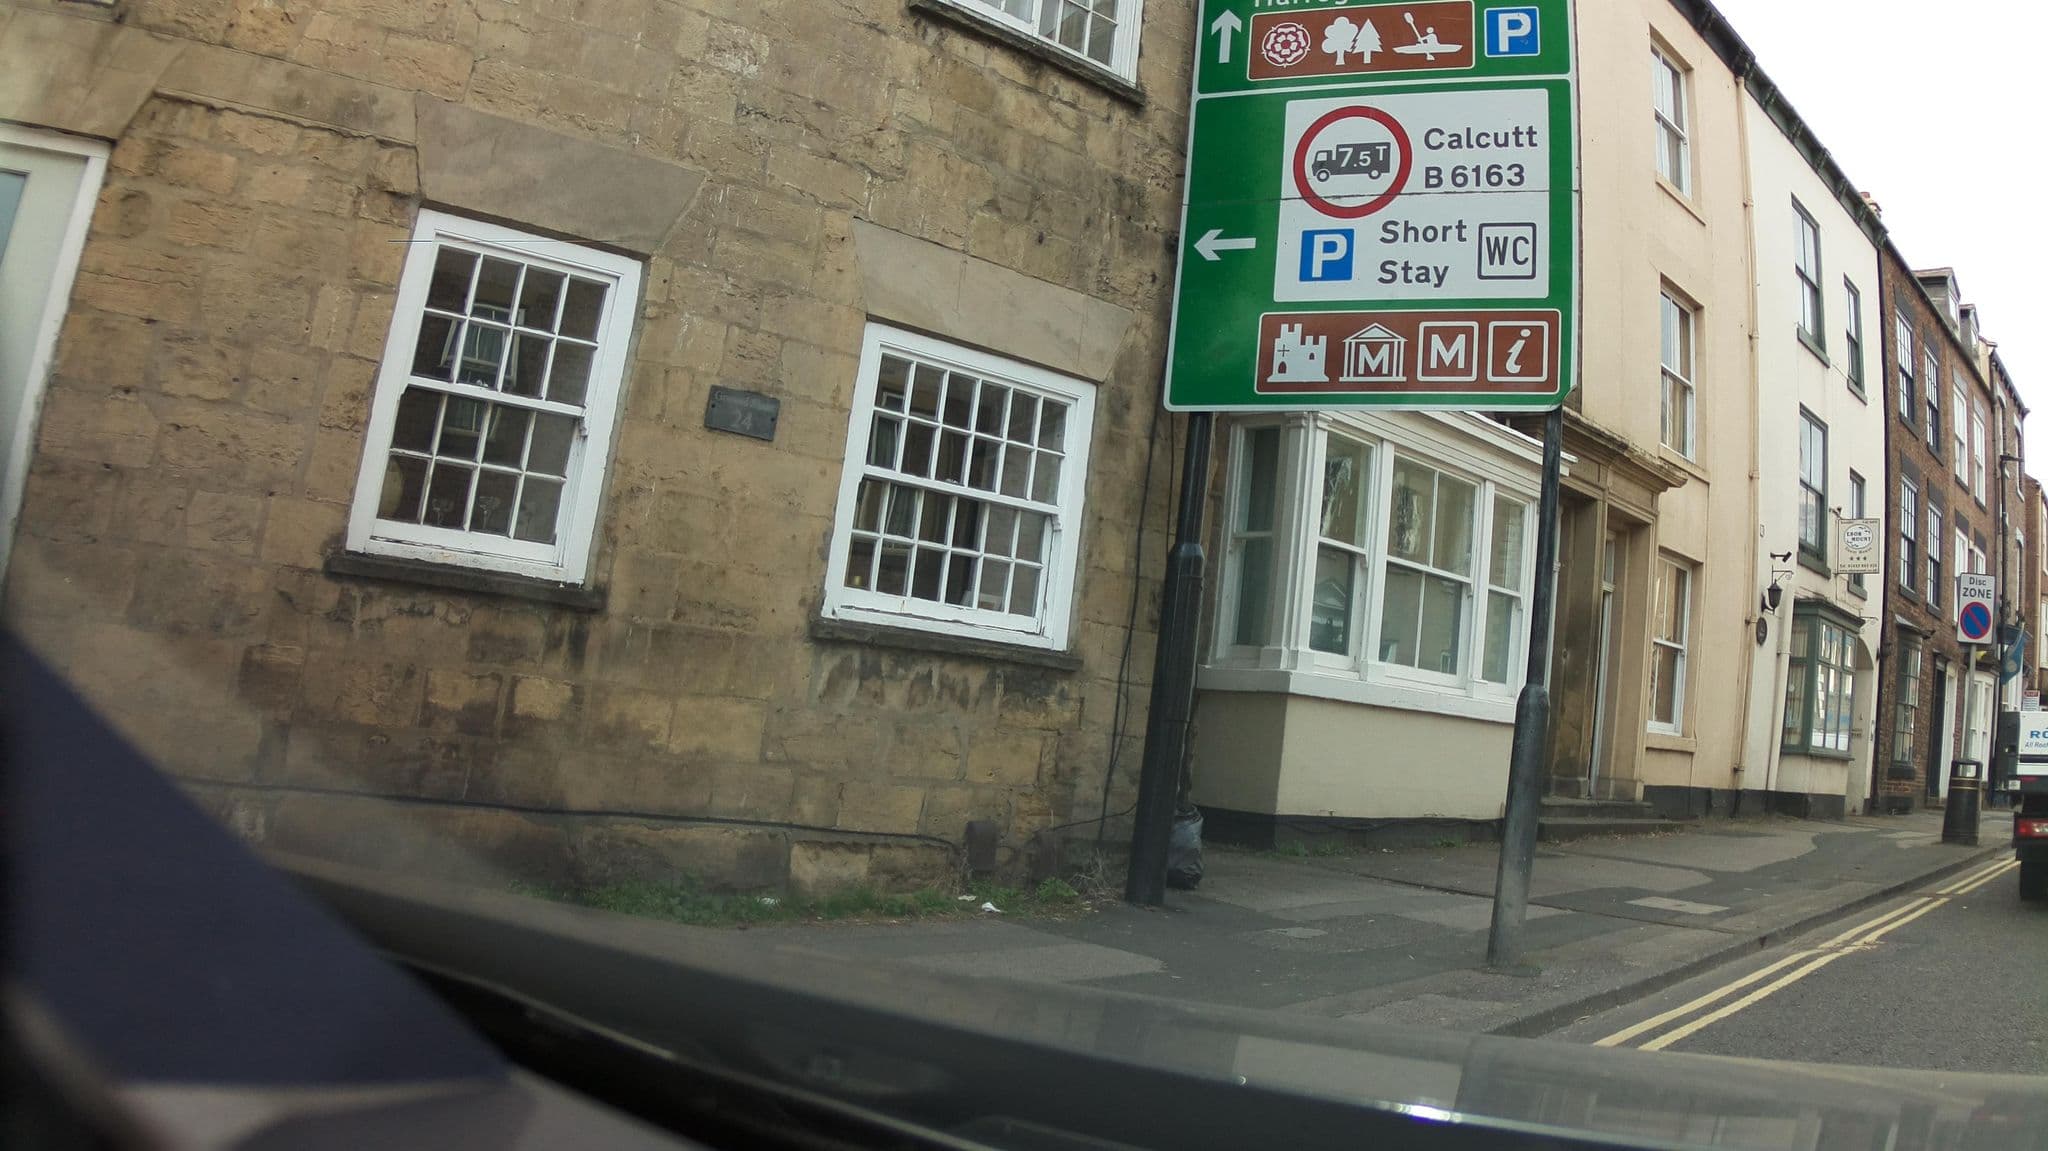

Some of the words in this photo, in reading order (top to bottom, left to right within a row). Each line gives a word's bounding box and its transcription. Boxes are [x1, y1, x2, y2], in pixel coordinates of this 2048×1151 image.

[1498, 12, 1531, 52] P
[1424, 126, 1538, 150] Calcutt
[1425, 166, 1443, 188] B
[1451, 163, 1525, 188] 6163
[1379, 219, 1467, 244] Short
[1311, 234, 1347, 278] P
[1486, 236, 1529, 266] WC
[1377, 260, 1449, 288] Stay
[1358, 343, 1390, 375] M
[1430, 333, 1466, 369] M
[1962, 587, 1992, 599] ZONE
[1969, 576, 1986, 586] Disc
